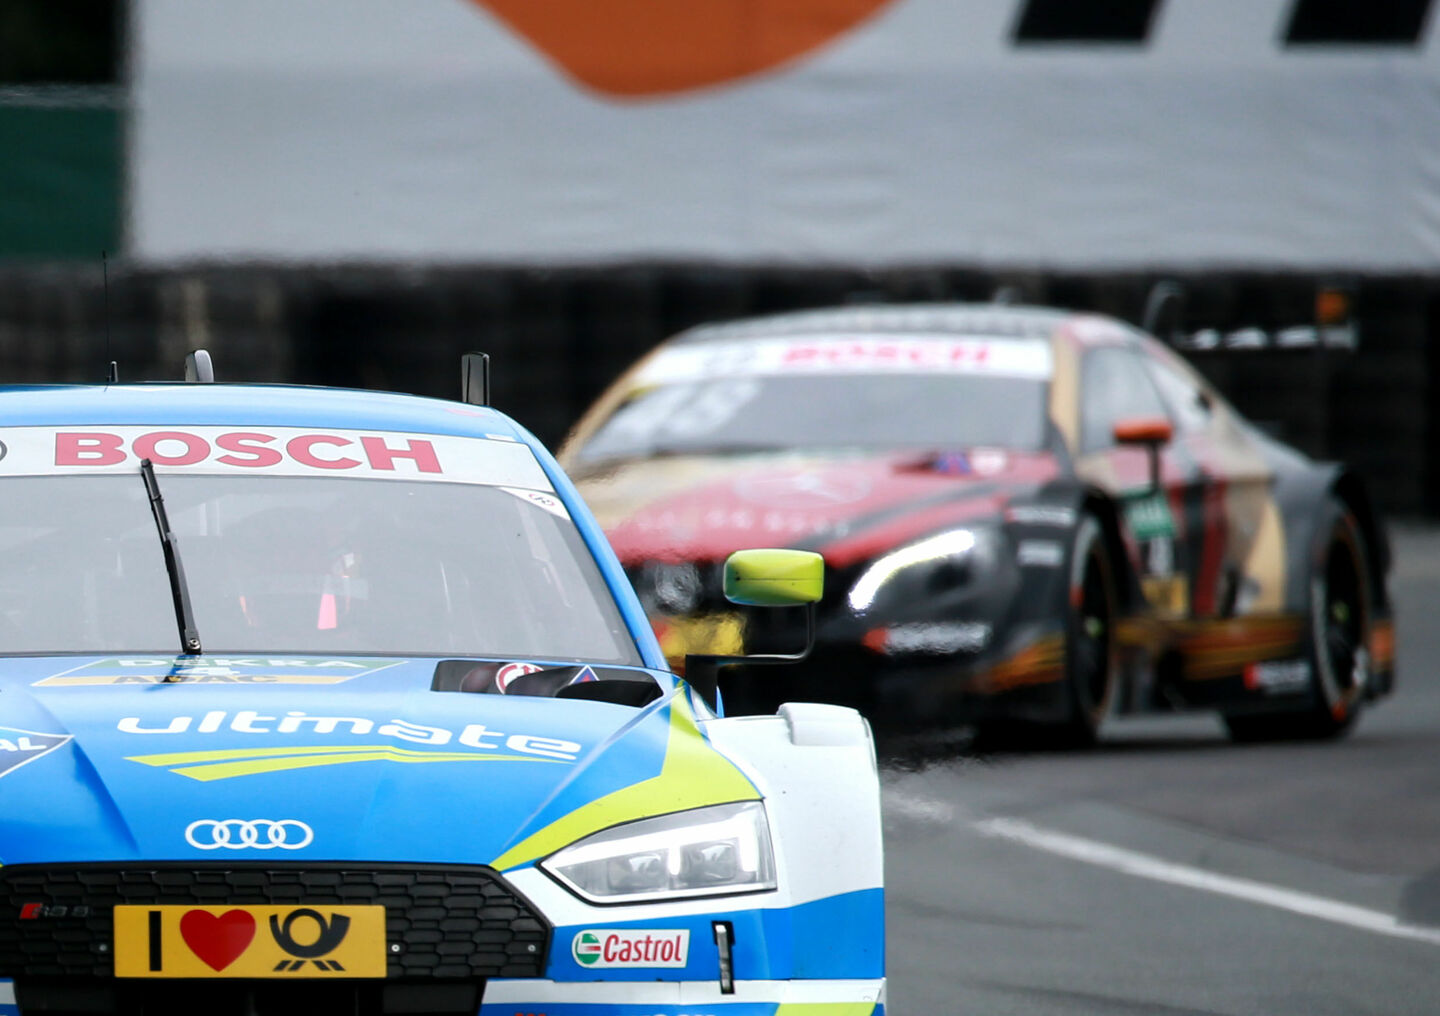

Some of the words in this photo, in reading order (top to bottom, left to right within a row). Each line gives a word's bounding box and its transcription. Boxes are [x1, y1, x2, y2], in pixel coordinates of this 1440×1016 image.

[54, 430, 443, 475] BOSCH
[117, 658, 369, 669] DEKRA
[175, 667, 241, 676] 4
[116, 709, 583, 762] ultimate
[149, 910, 163, 972] I
[603, 933, 682, 963] Castrol
